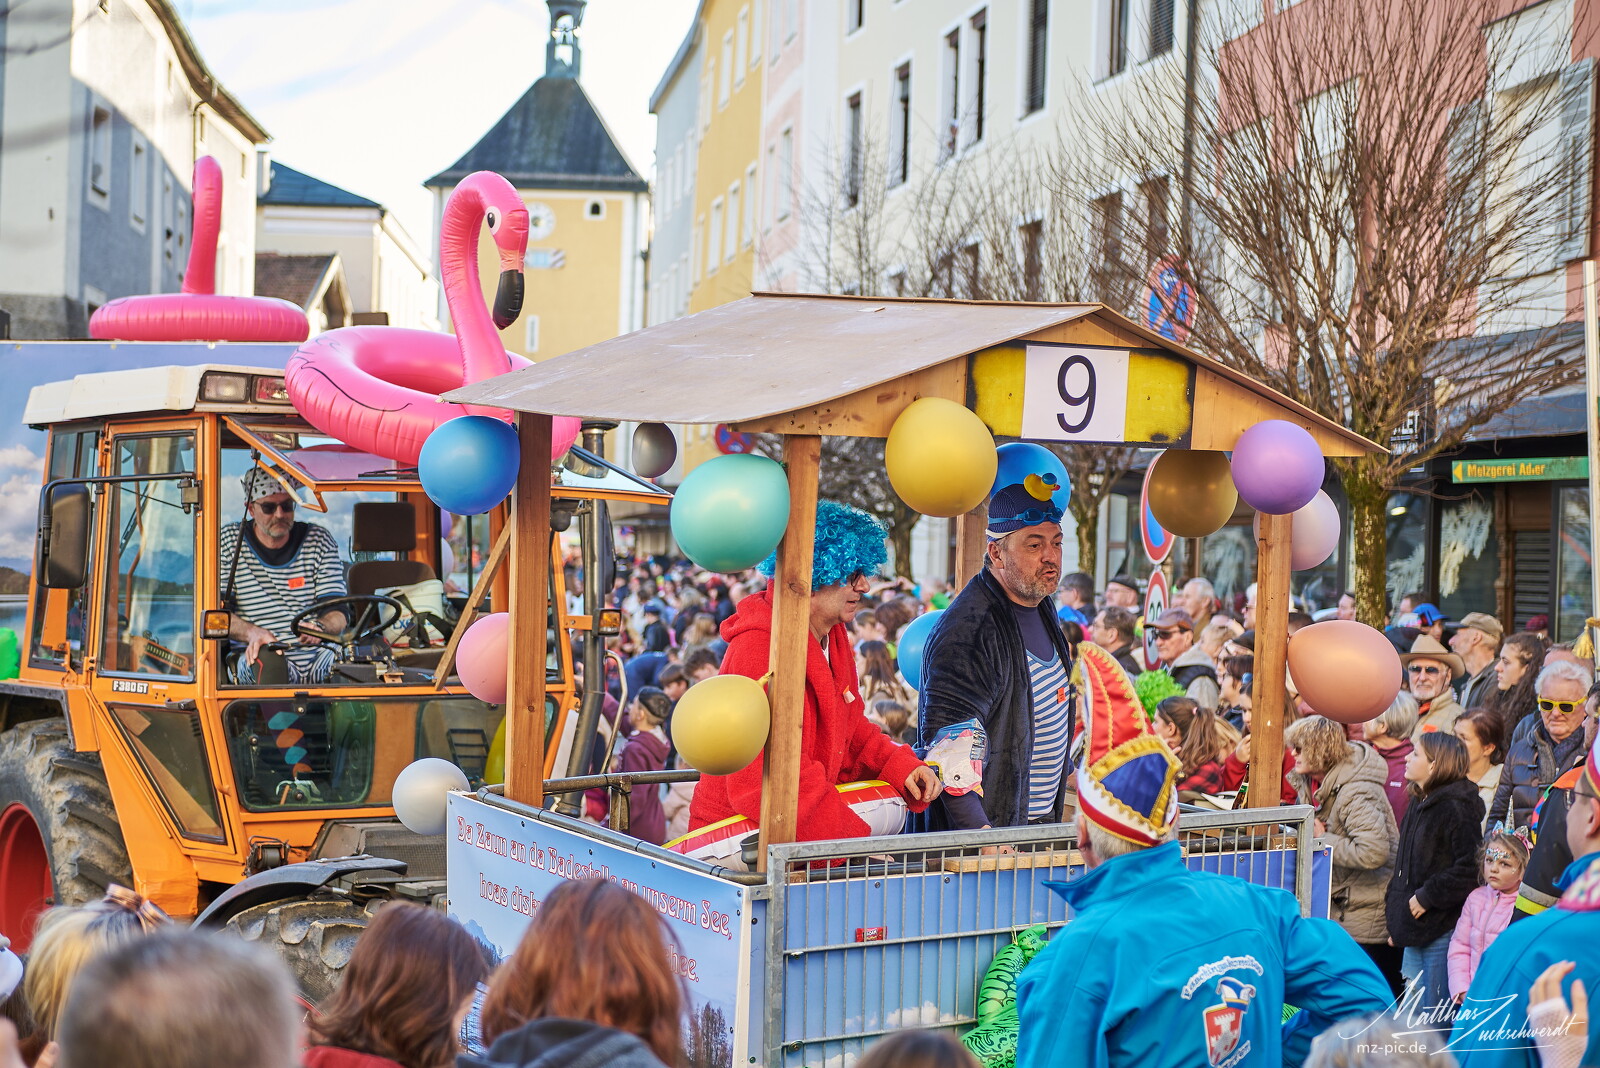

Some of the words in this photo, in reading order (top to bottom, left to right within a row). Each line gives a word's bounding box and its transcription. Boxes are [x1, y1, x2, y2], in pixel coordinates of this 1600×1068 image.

[1057, 355, 1097, 433] 9
[1467, 463, 1516, 478] Metzgerei
[457, 815, 473, 845] Da
[475, 822, 507, 857] Zaun
[510, 839, 526, 864] an
[529, 841, 545, 870] da
[642, 885, 697, 925] unserm
[700, 899, 733, 940] See,
[479, 872, 508, 907] hoas
[665, 943, 700, 983] hee.
